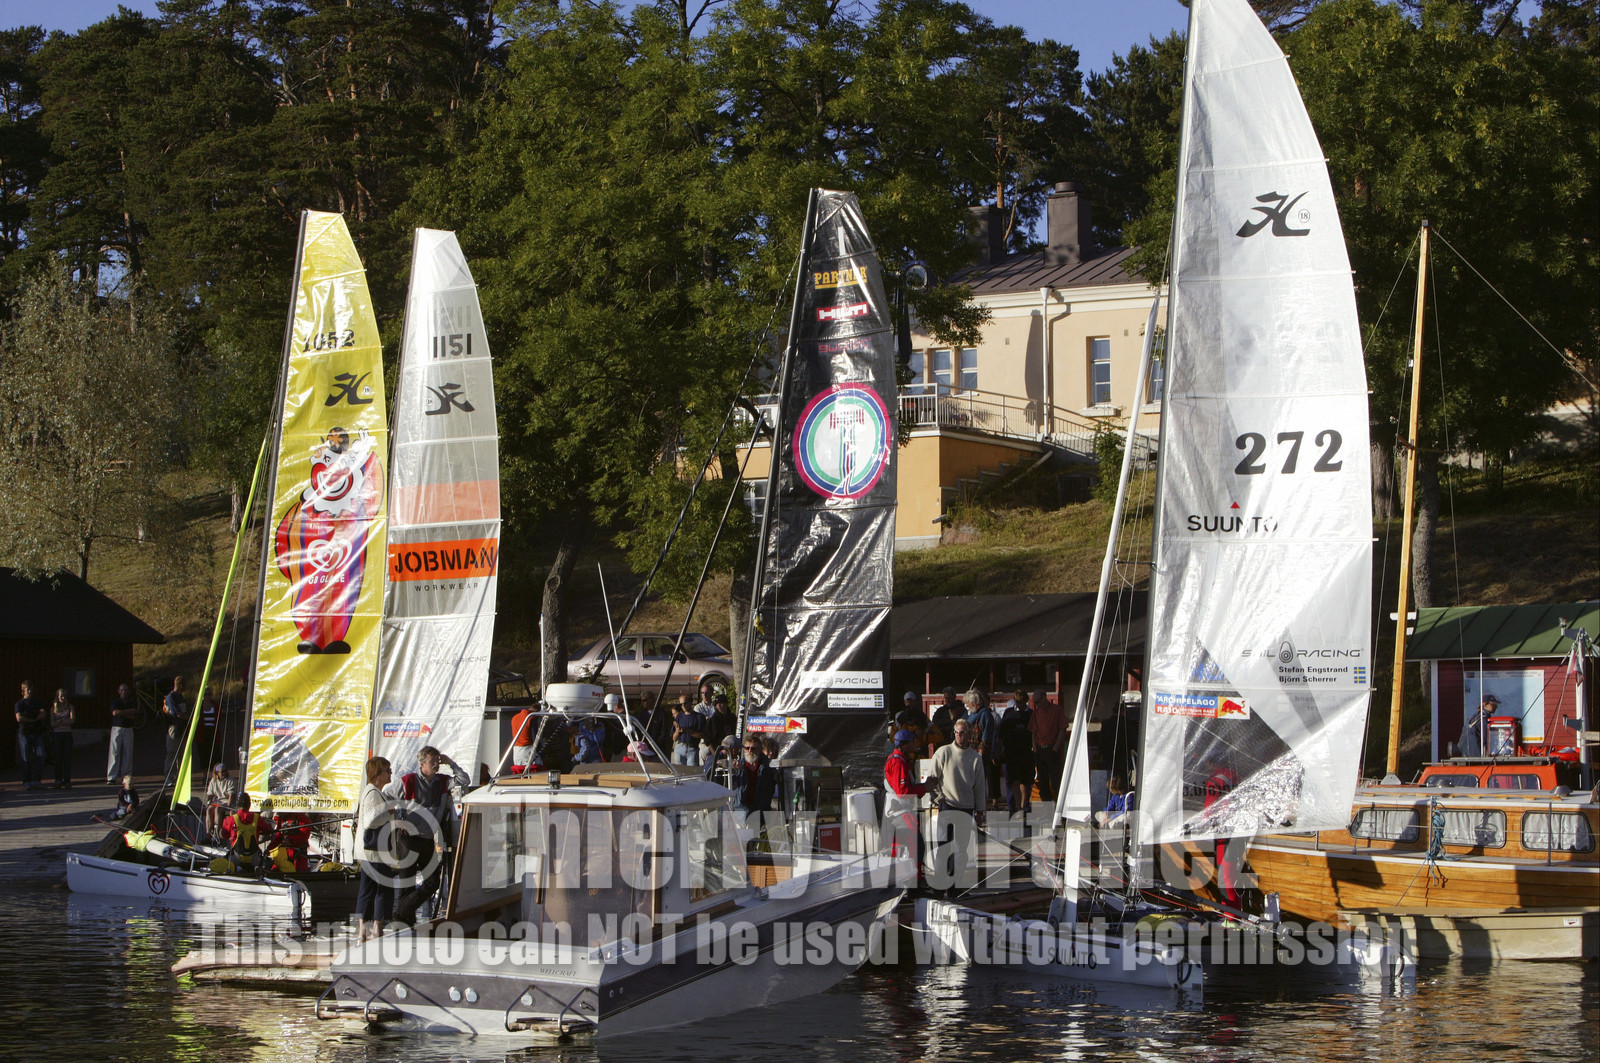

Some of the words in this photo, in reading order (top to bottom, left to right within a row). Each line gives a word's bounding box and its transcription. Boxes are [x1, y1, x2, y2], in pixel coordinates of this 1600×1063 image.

[433, 333, 472, 358] 1151
[1234, 429, 1343, 475] 272
[1187, 515, 1279, 533] SUUNTO
[394, 546, 494, 574] JOBMAN
[320, 574, 345, 583] GLE
[415, 582, 478, 592] WORKWEAR
[1296, 649, 1361, 658] RACING
[1279, 666, 1305, 674] Stefan
[1307, 666, 1348, 676] Engstrand
[1279, 675, 1300, 684] Björn
[1302, 675, 1337, 683] Scherrer
[1157, 695, 1216, 707] ARCHIPELAGO
[1156, 706, 1180, 715] RAID
[1047, 946, 1097, 969] SUUNTO
